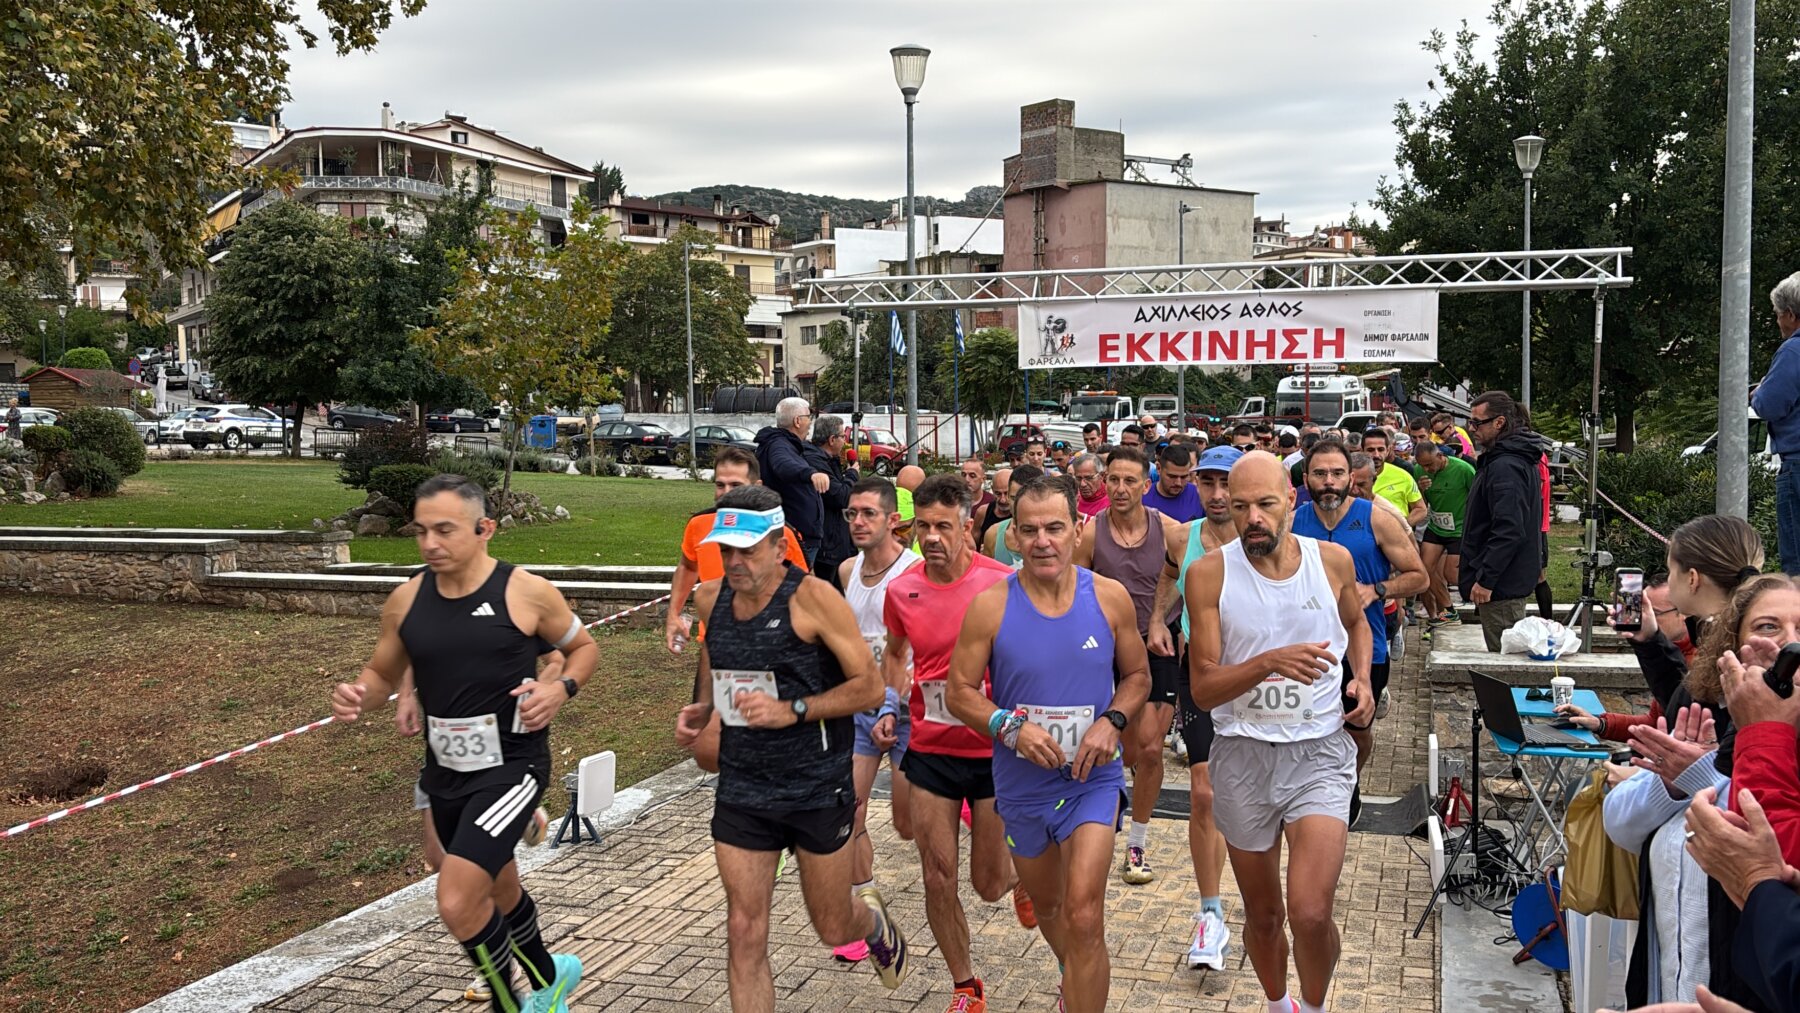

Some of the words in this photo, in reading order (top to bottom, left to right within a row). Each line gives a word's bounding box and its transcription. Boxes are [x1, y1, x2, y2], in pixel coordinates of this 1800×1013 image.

[1134, 303, 1231, 323] ΑΧΙΛΛΕΙΟΣ
[1239, 301, 1303, 319] ΑΘΛΟΣ
[1099, 327, 1345, 364] ΕΚΚΙΝΗΣΗ
[1363, 333, 1389, 342] ΔΗΜΟΥ
[1390, 332, 1430, 342] ΦΑΡΣΑΛΩΝ
[1028, 356, 1076, 366] ΦΑΡΣΑΛΑ
[1247, 685, 1301, 710] 205
[439, 733, 486, 757] 233
